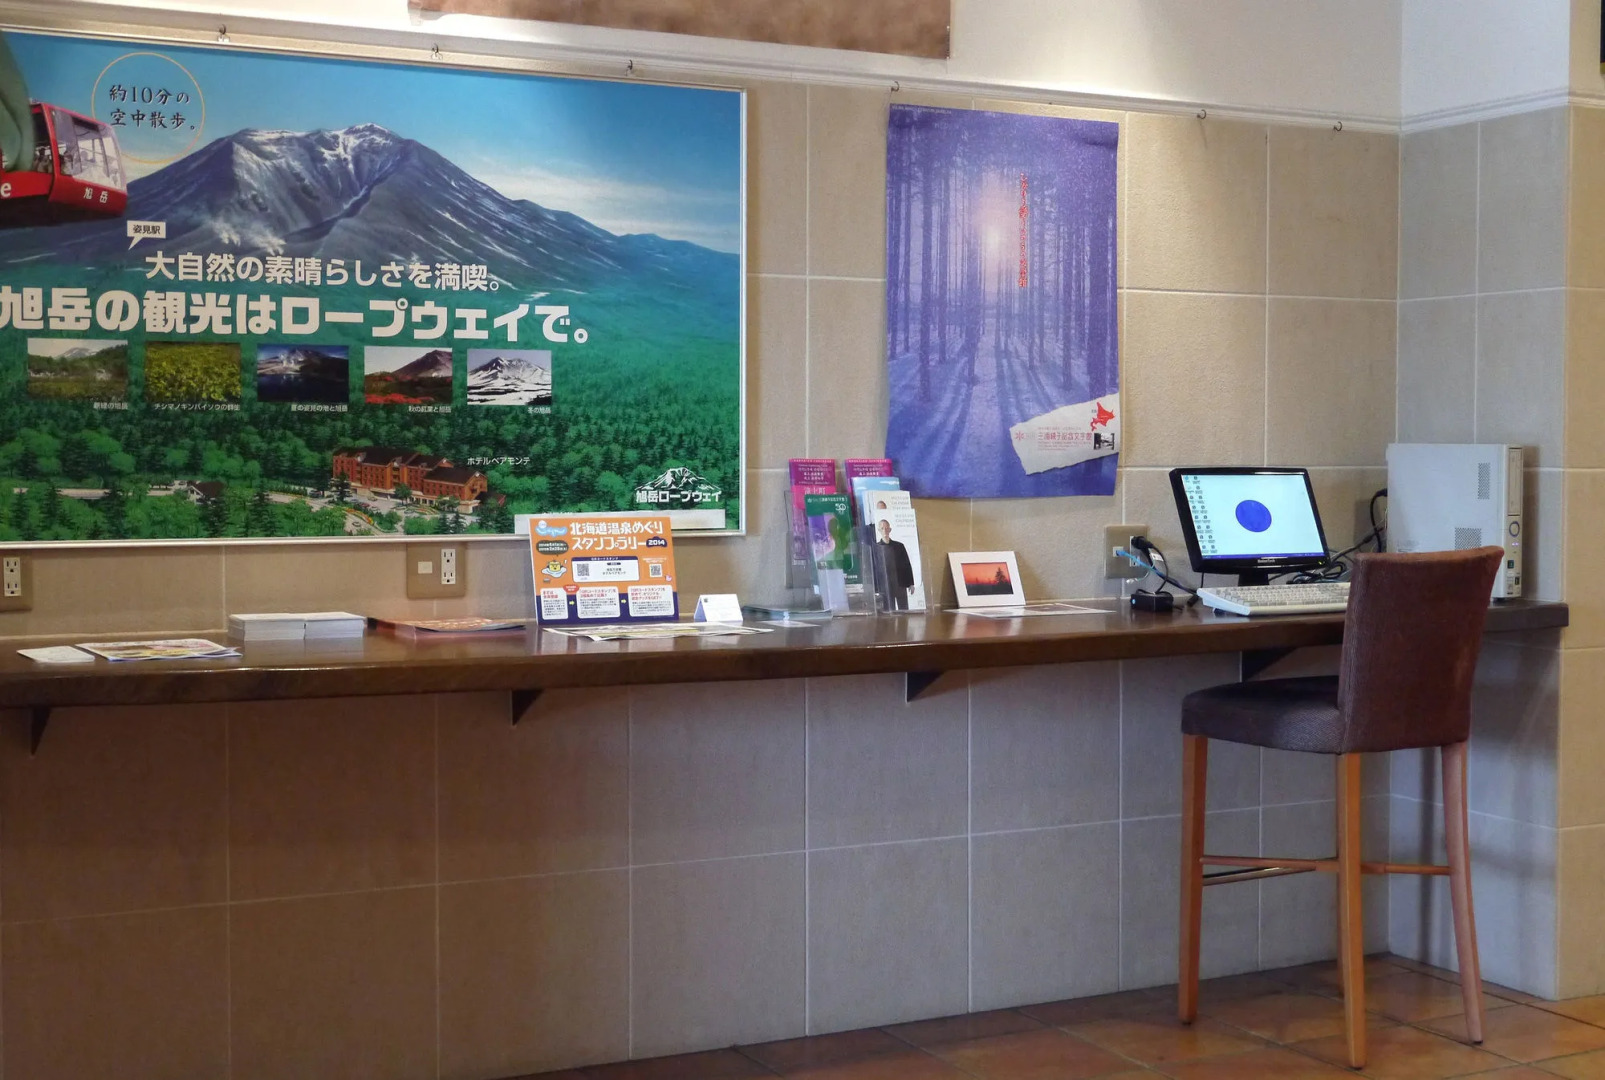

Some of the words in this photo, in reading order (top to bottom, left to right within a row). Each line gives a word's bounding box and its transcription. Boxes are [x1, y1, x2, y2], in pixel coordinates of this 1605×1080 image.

[109, 84, 191, 105] 約10分の
[110, 109, 196, 132] 空中散歩。
[83, 187, 108, 204] 旭岳
[132, 225, 161, 235] 姿見駅
[145, 251, 500, 294] 大自然の素晴らしさを満喫。
[0, 285, 589, 344] 旭岳の観光はロープウェイで。
[467, 456, 531, 466] ホテルベアモンテ
[636, 490, 722, 504] 旭岳ロープウェイ
[570, 521, 664, 536] 北海道温泉めぐり
[572, 537, 647, 551] スタンプラリー
